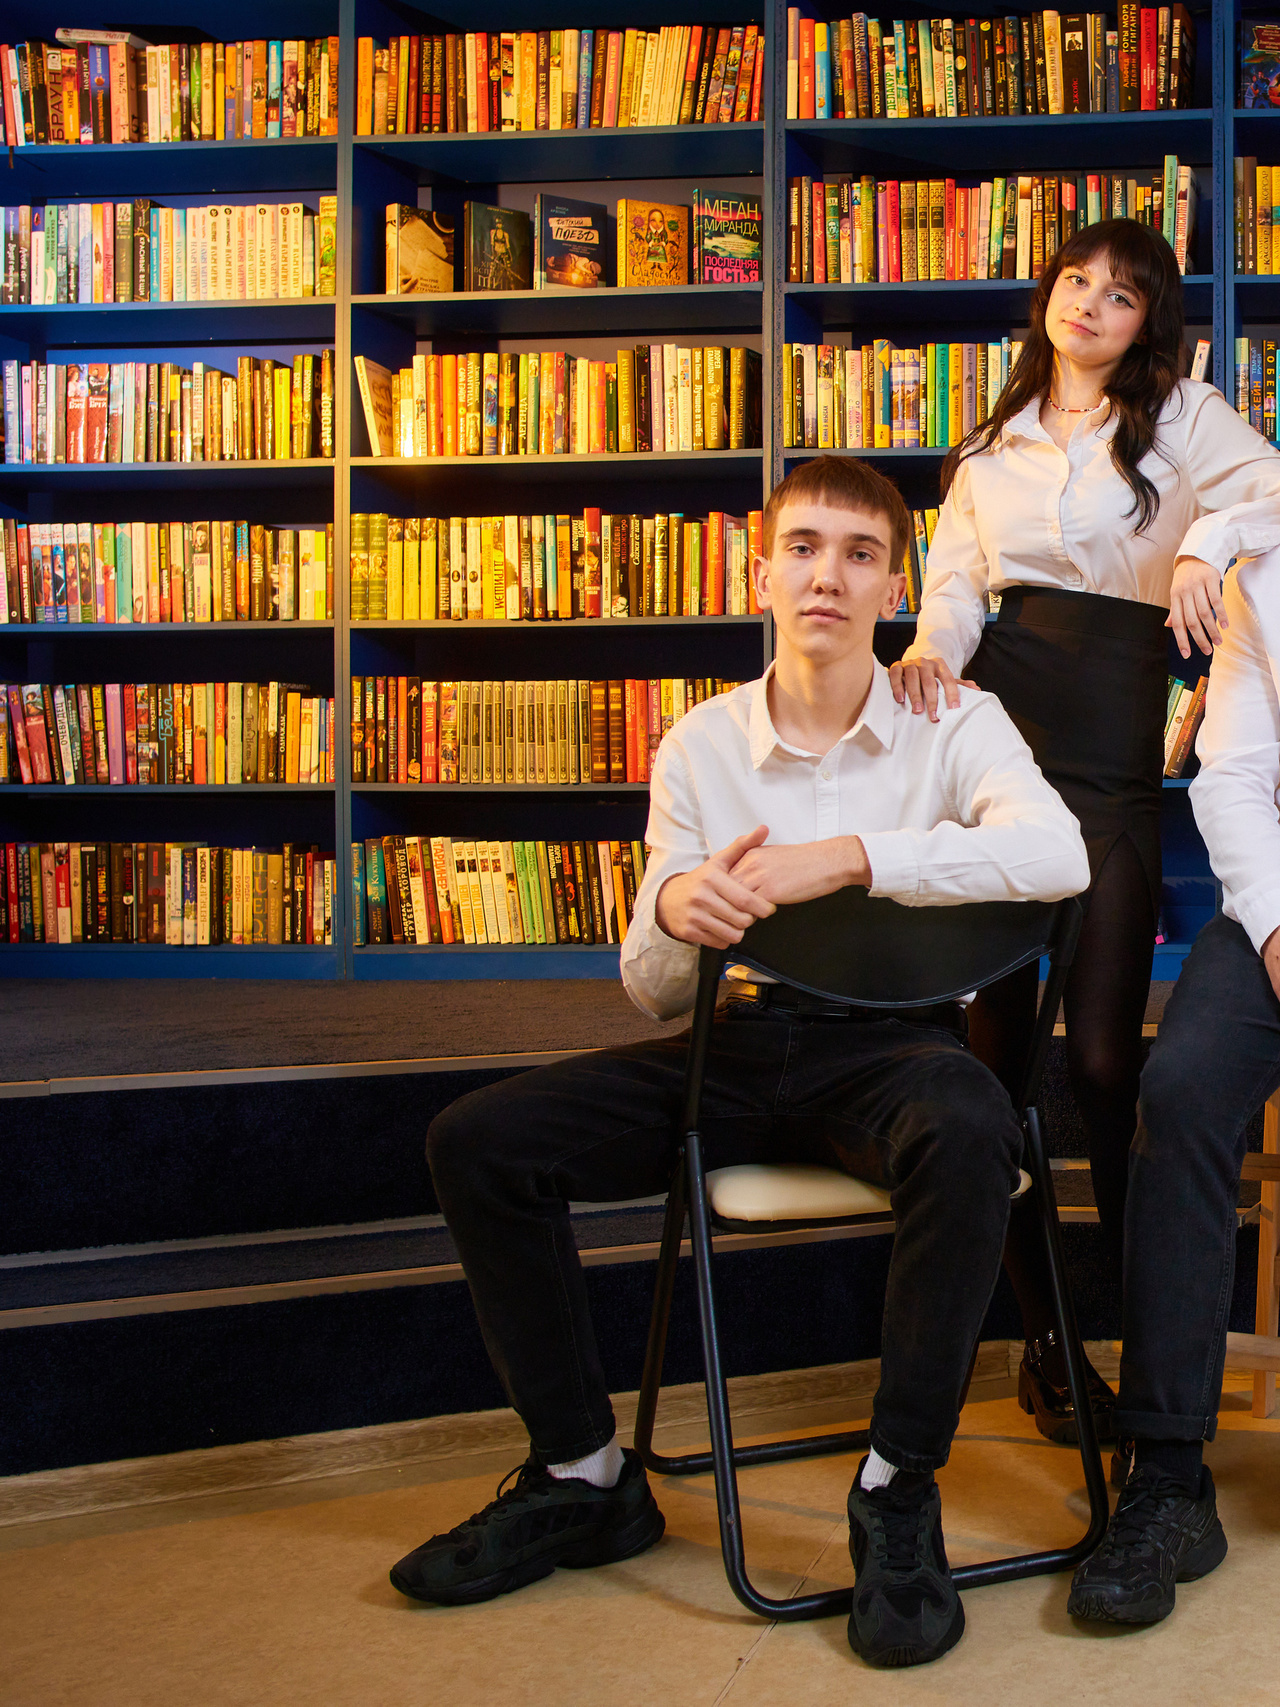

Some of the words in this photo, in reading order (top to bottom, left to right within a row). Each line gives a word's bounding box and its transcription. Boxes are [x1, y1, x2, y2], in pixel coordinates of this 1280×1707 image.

[1122, 31, 1130, 52] ГОРЫ
[1129, 4, 1137, 44] ГИГАНТЫ
[885, 71, 896, 110] ДЕЛАКУР
[945, 64, 955, 107] ДЮБУА
[47, 72, 64, 141] БРАУН
[704, 198, 758, 220] МЕГАН
[1177, 201, 1187, 237] ЗЮСКИНД
[704, 218, 759, 236] МИРАНДА
[704, 255, 759, 269] ПОСЛЕДНЯЯ
[1176, 238, 1185, 266] ПАТРИК
[1263, 230, 1271, 265] КАССЛЕР
[704, 266, 759, 283] ГОСТЬЯ
[977, 352, 986, 396] ДАРИЕН
[1252, 381, 1262, 411] КЕЙН
[320, 393, 332, 447] ЗАГОВОР
[519, 397, 528, 440] ЛЕГЕНДА
[252, 554, 262, 583] ВДОВА
[55, 702, 68, 746] ОЧЕВИДЕЦ
[370, 845, 380, 884] Кукушки
[398, 848, 409, 891] ХОРОВОД
[434, 843, 448, 889] ГАРДИНЕР
[371, 886, 380, 902] Зов
[459, 884, 470, 907] ГУДЕН
[471, 884, 481, 907] ГУДЕН
